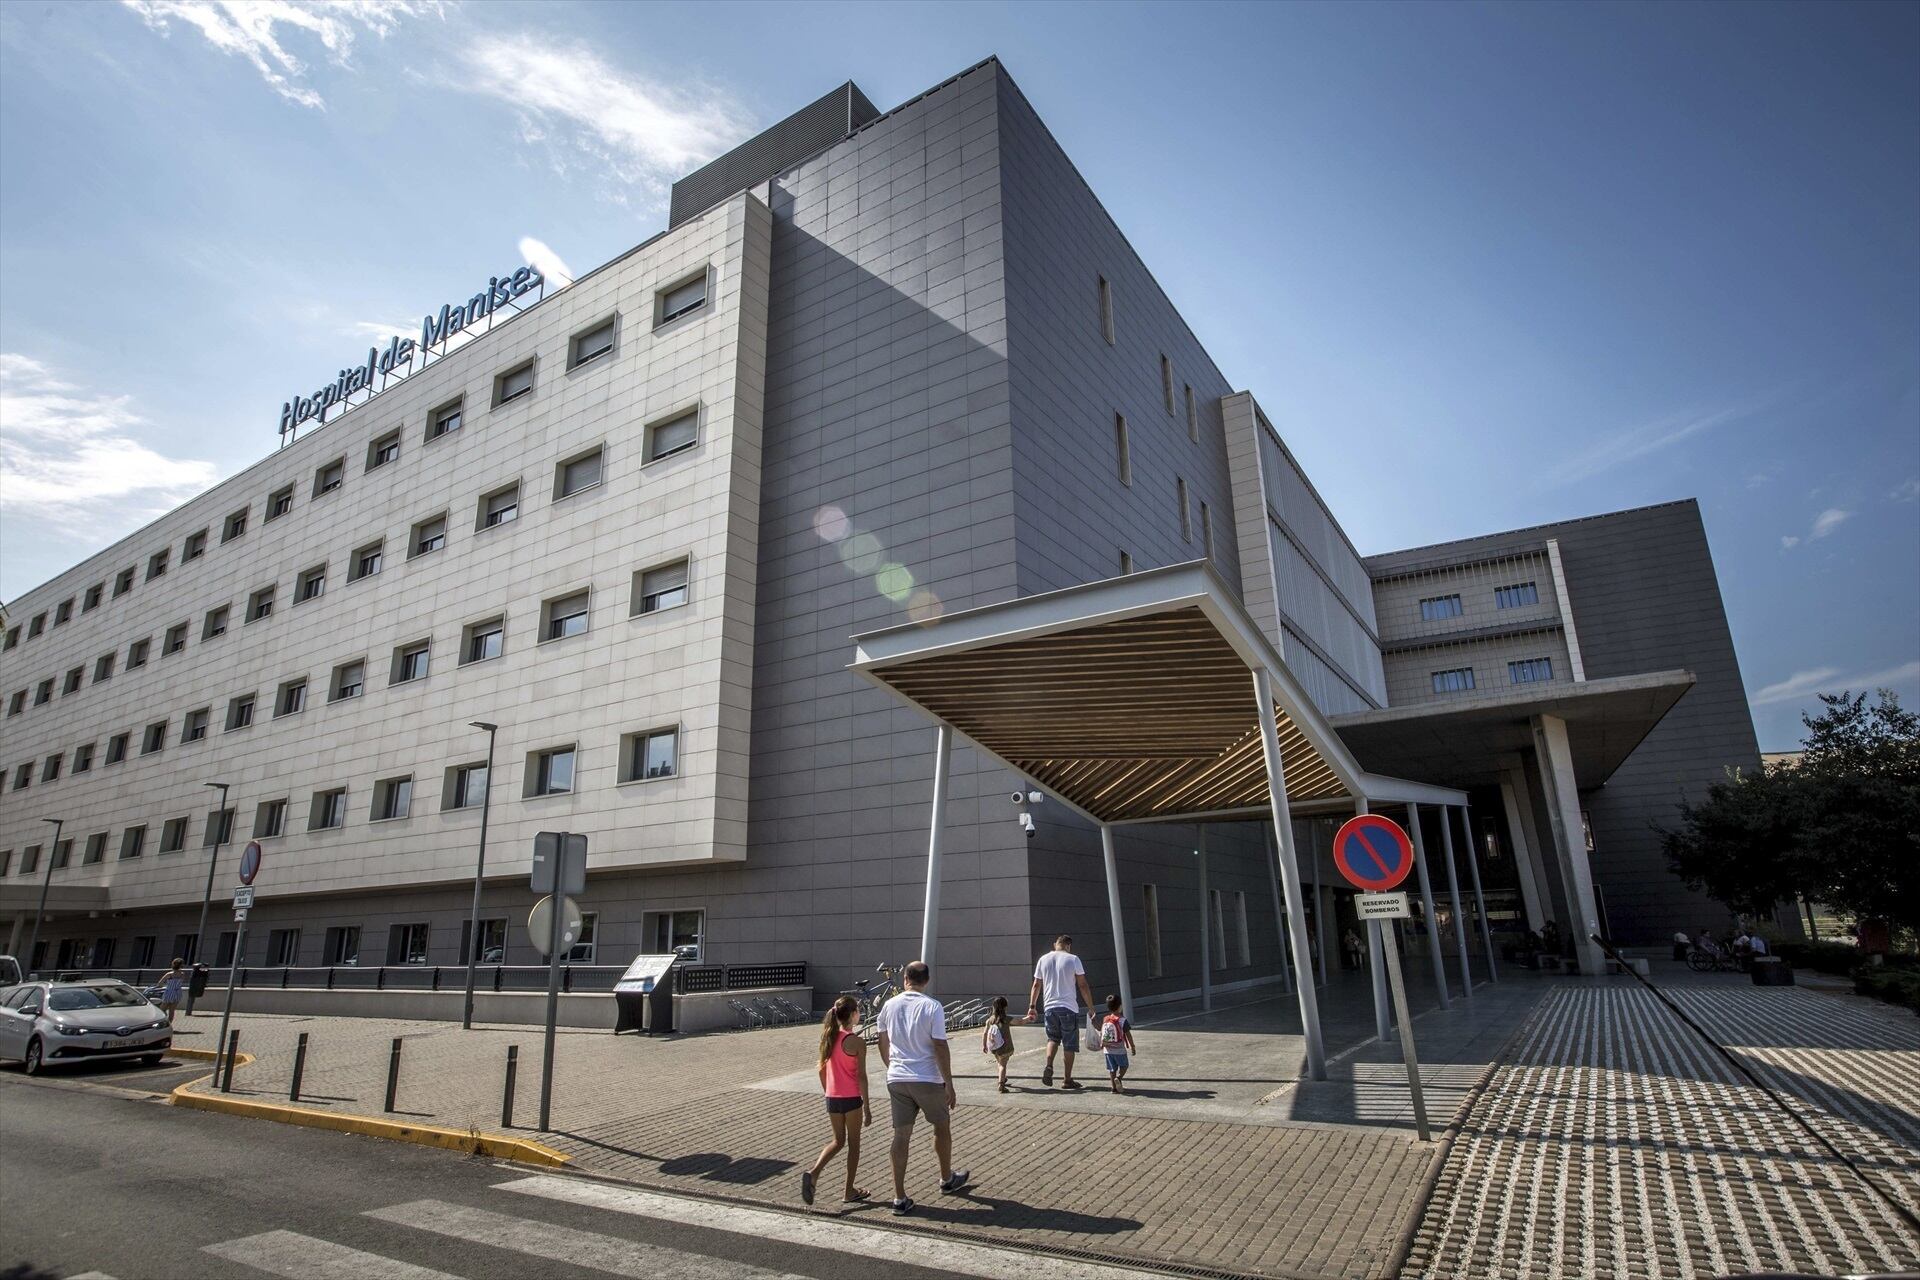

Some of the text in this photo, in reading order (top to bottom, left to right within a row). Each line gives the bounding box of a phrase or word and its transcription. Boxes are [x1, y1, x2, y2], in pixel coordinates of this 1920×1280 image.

[279, 263, 545, 434] Hospital de Manises
